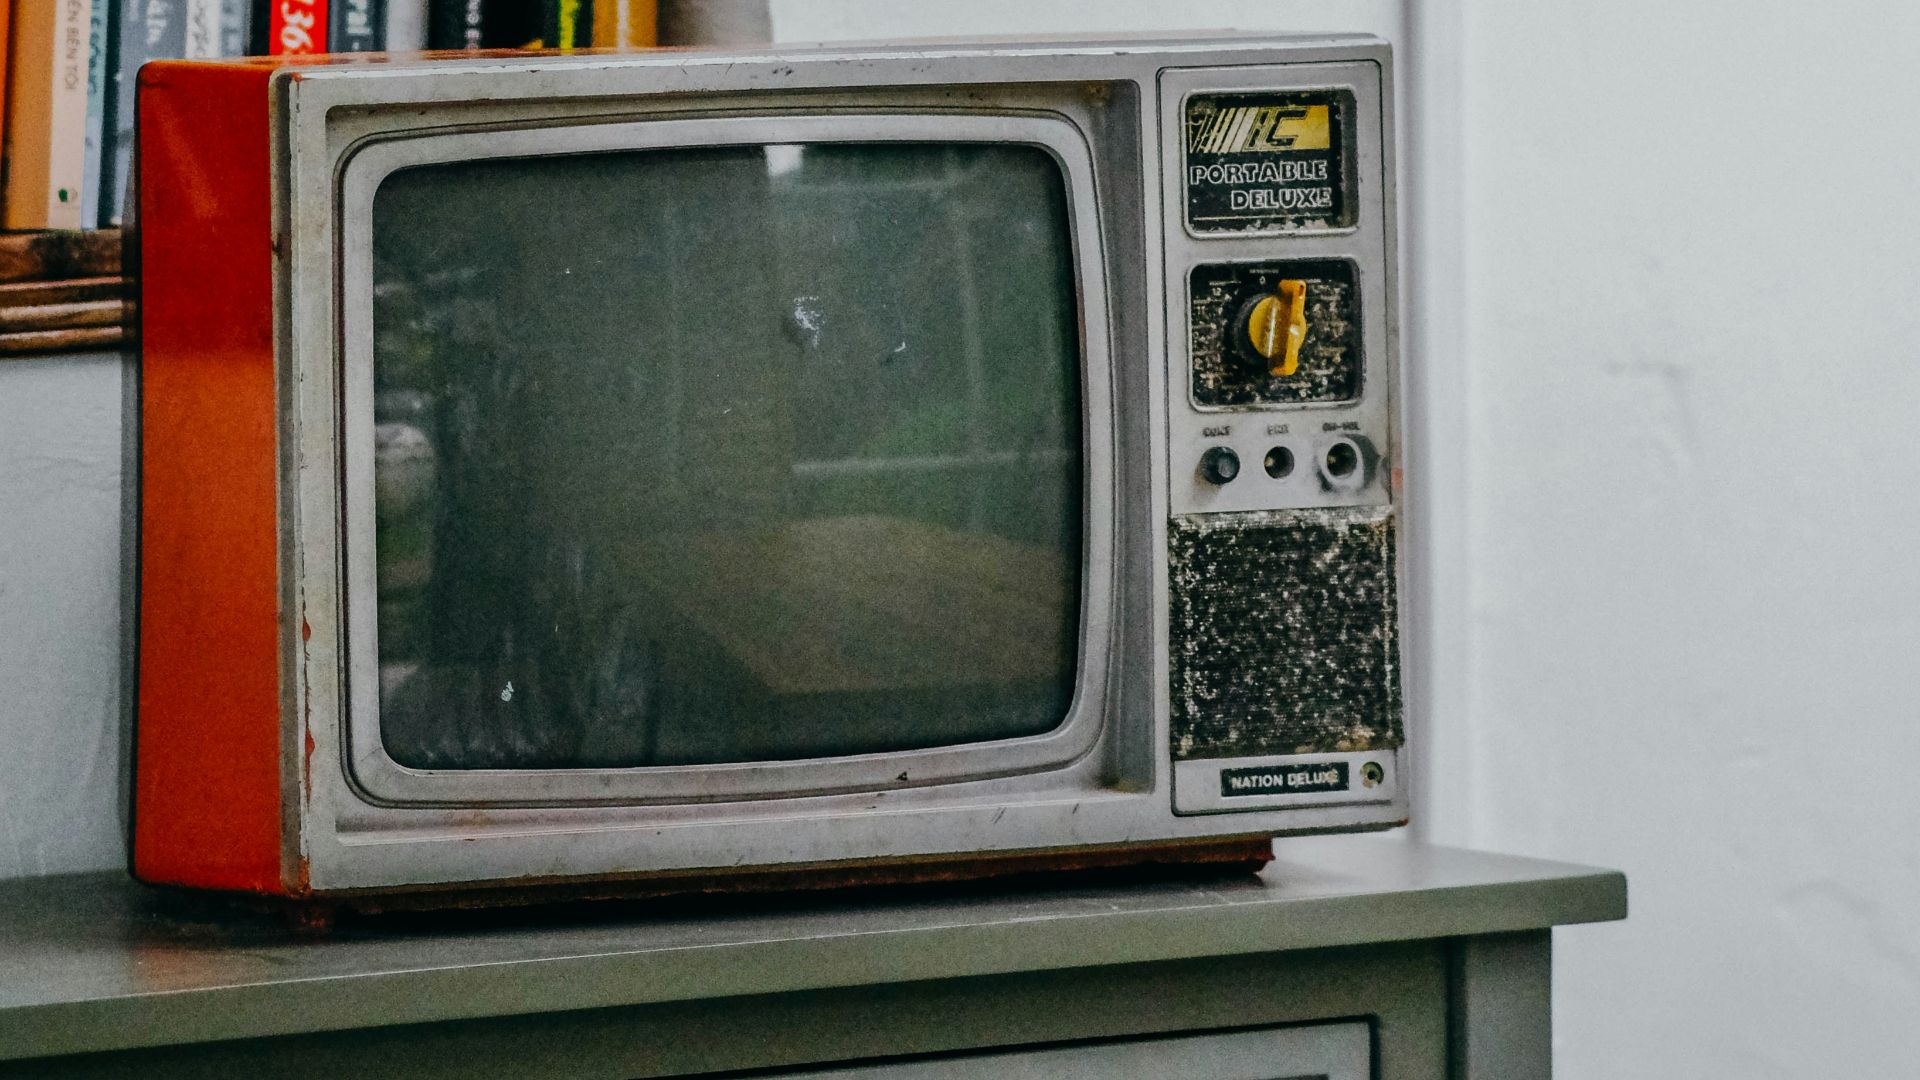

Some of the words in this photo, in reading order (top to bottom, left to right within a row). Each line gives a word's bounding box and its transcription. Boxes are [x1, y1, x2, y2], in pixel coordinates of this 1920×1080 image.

[1190, 160, 1328, 185] PORTABLE
[1231, 187, 1332, 210] DELUXE
[1231, 774, 1283, 789] NATION
